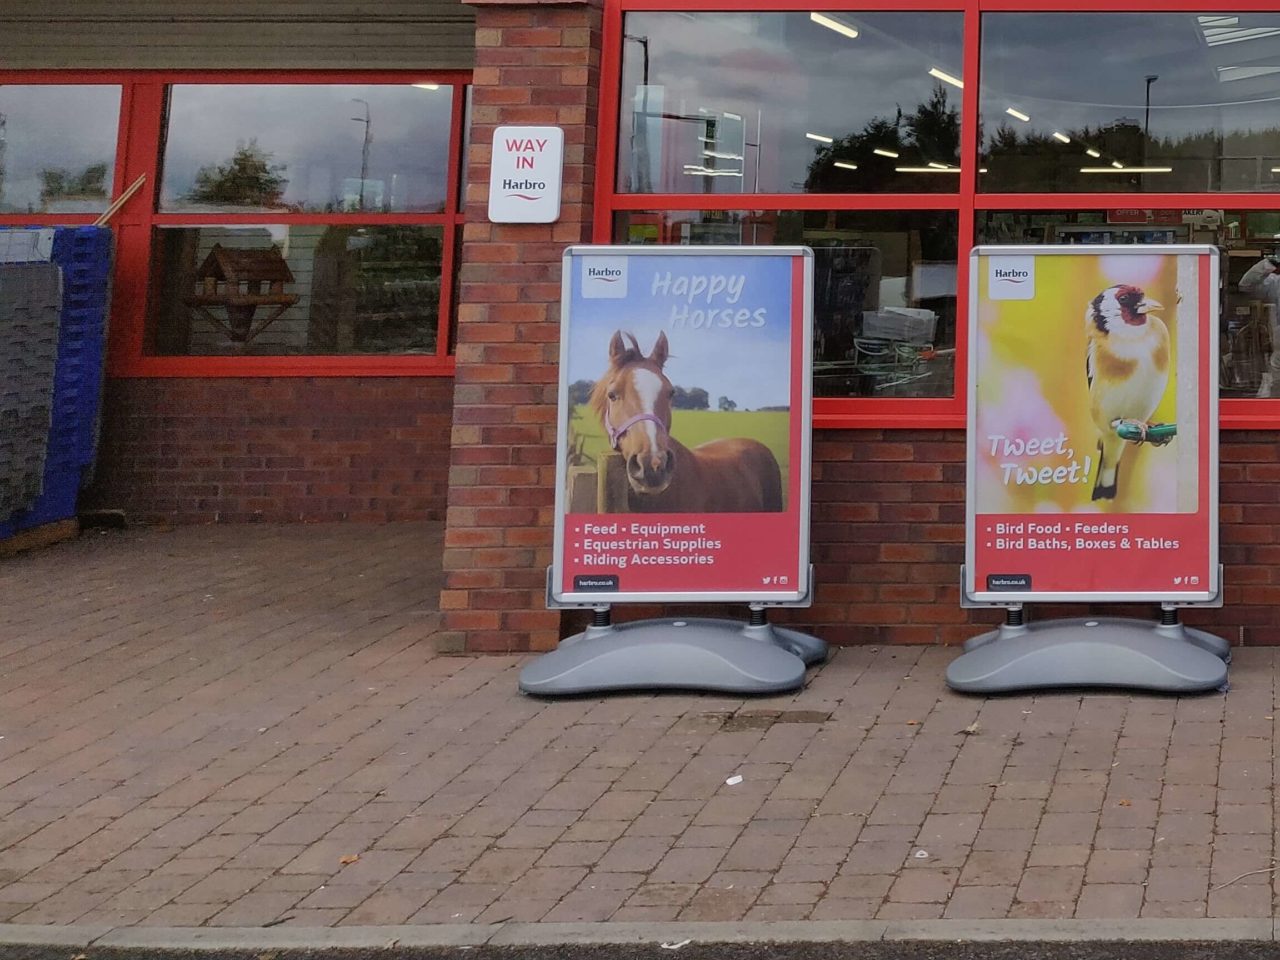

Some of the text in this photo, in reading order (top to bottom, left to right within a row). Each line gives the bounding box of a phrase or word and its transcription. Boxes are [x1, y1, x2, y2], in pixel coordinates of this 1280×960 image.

[505, 139, 548, 152] WAY
[516, 156, 534, 169] IN
[502, 179, 546, 190] Harbro
[588, 267, 621, 278] Harbro
[995, 268, 1028, 278] Harbro
[651, 272, 746, 305] Happy
[669, 305, 767, 329] Horses
[988, 433, 1075, 459] Tweet,
[1000, 456, 1092, 485] Tweet!
[584, 523, 705, 537] Feed Equipment
[996, 523, 1129, 534] Bird Food Feeders
[584, 538, 722, 552] Equestrian Supplies
[996, 538, 1180, 551] Bird Baths, Boxes & Tables
[583, 554, 714, 568] Riding Accessories
